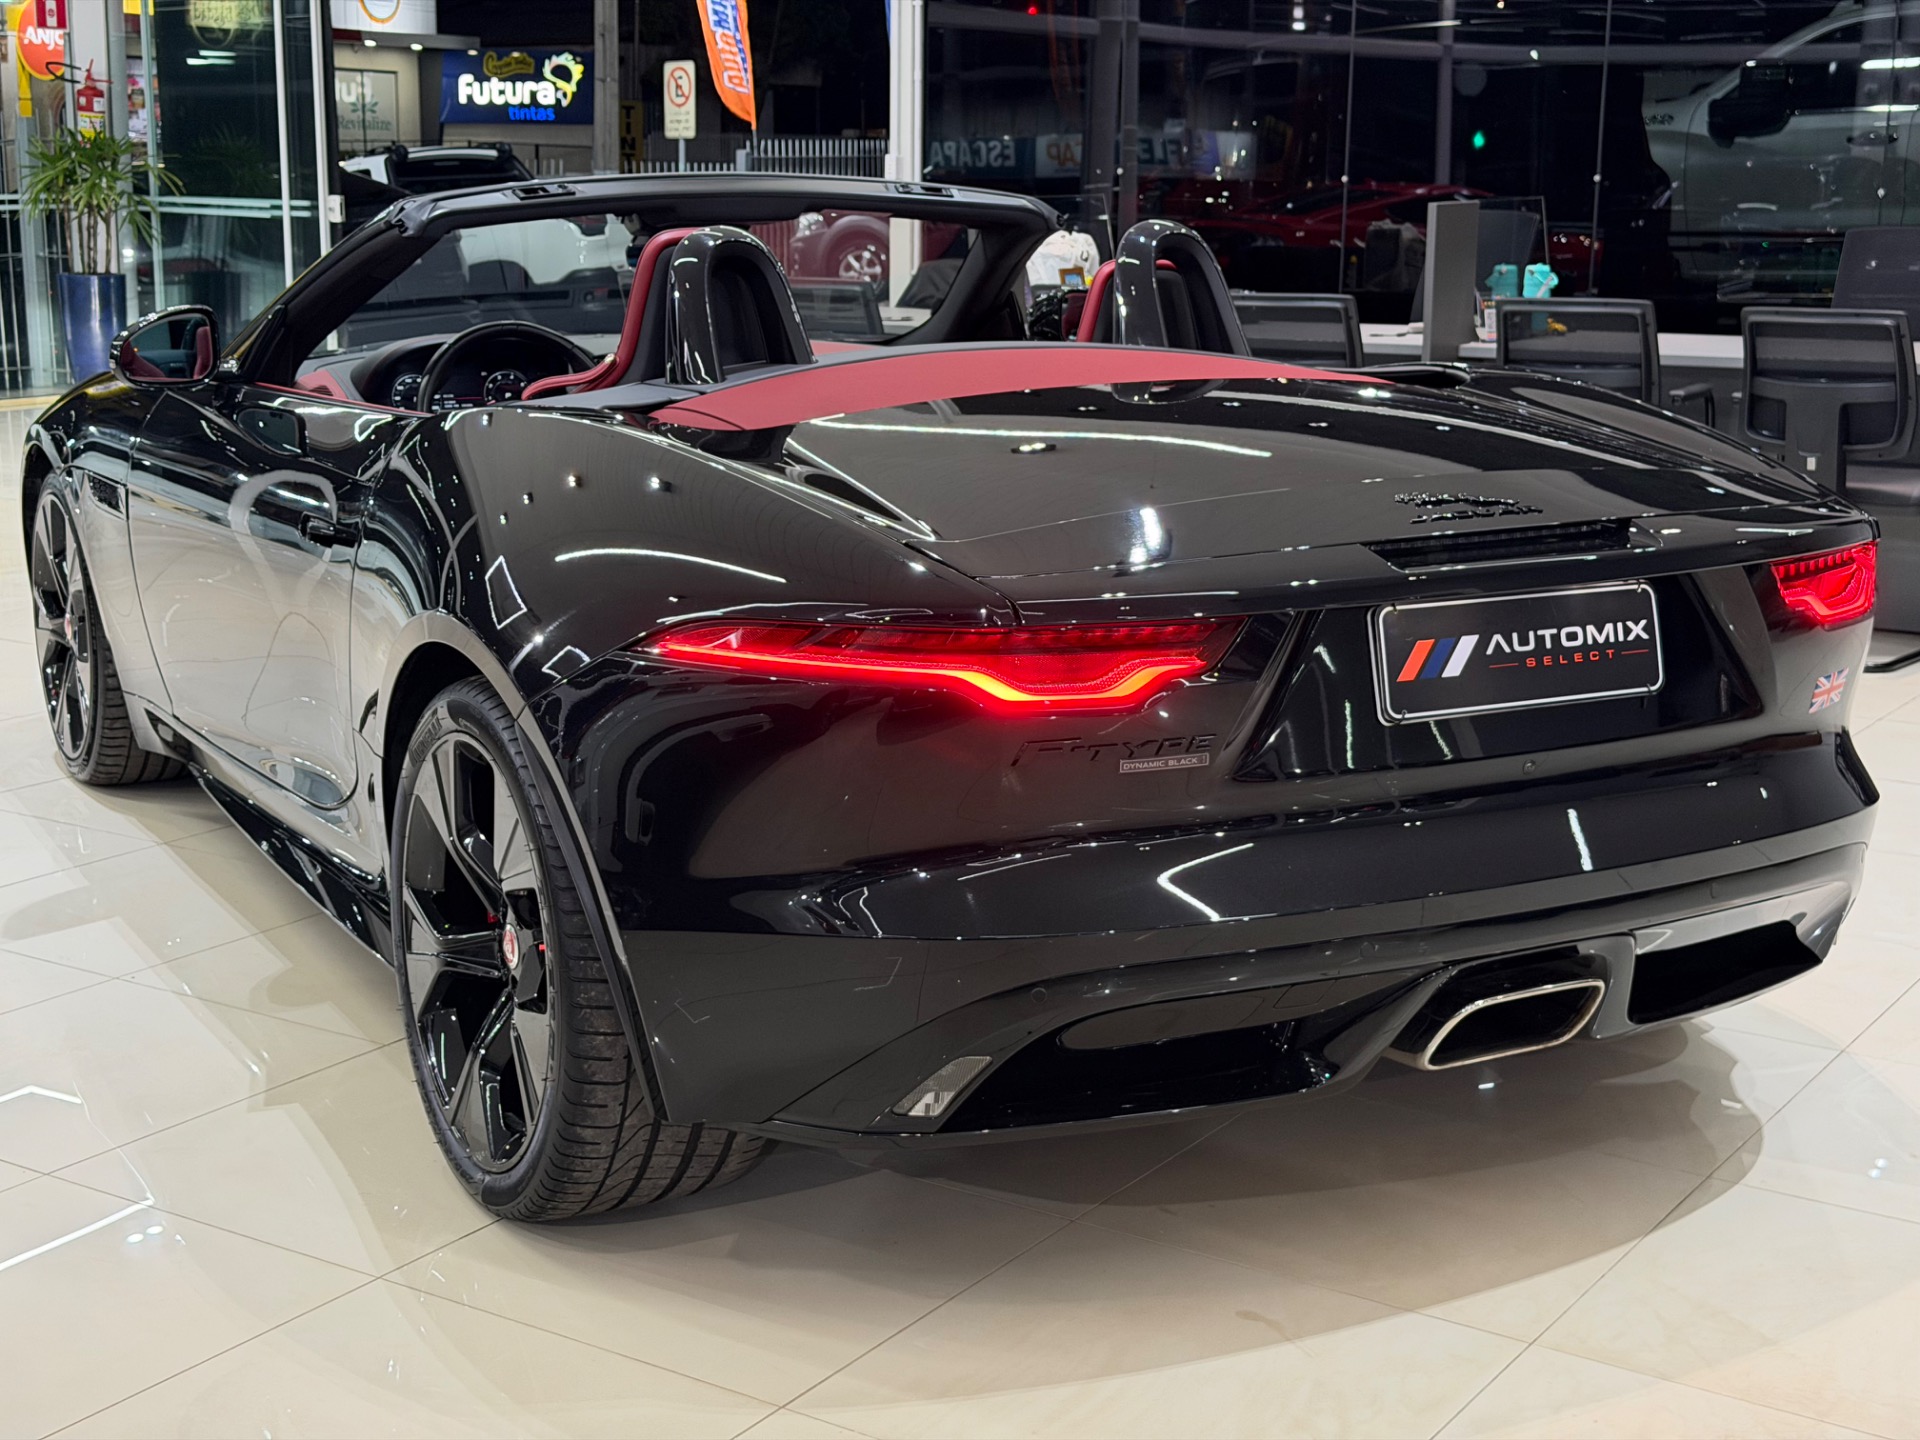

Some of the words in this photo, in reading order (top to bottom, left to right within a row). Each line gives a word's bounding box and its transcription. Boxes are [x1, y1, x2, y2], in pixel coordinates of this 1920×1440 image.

[458, 73, 556, 105] Futura
[508, 105, 556, 121] tintas
[1486, 619, 1650, 656] AUTOMIX
[1525, 649, 1615, 668] SELECT
[1123, 760, 1166, 770] DYNAMIC
[1167, 756, 1198, 767] BLACK
